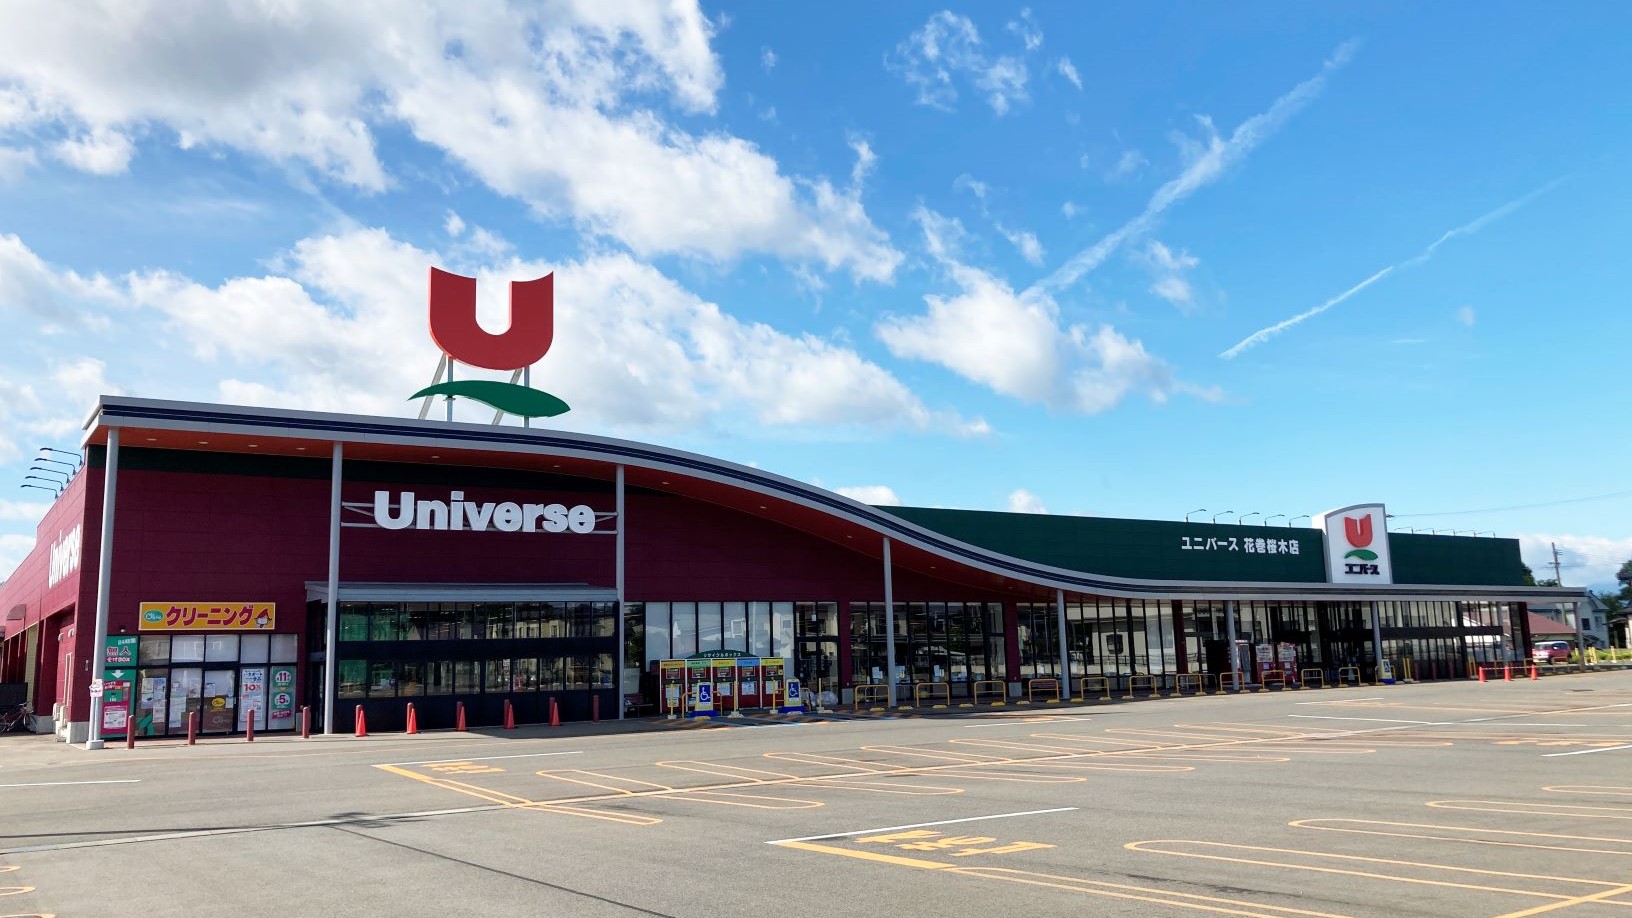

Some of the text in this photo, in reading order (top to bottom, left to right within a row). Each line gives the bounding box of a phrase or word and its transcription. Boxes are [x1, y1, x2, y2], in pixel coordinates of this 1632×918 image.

[428, 266, 554, 371] U
[374, 490, 596, 534] Universe
[1181, 537, 1300, 555] ユニバース 花巻桜木店
[1344, 513, 1373, 548] U
[48, 523, 80, 589] Universe
[1344, 563, 1380, 575] ユニバース
[166, 605, 254, 626] クリーニング
